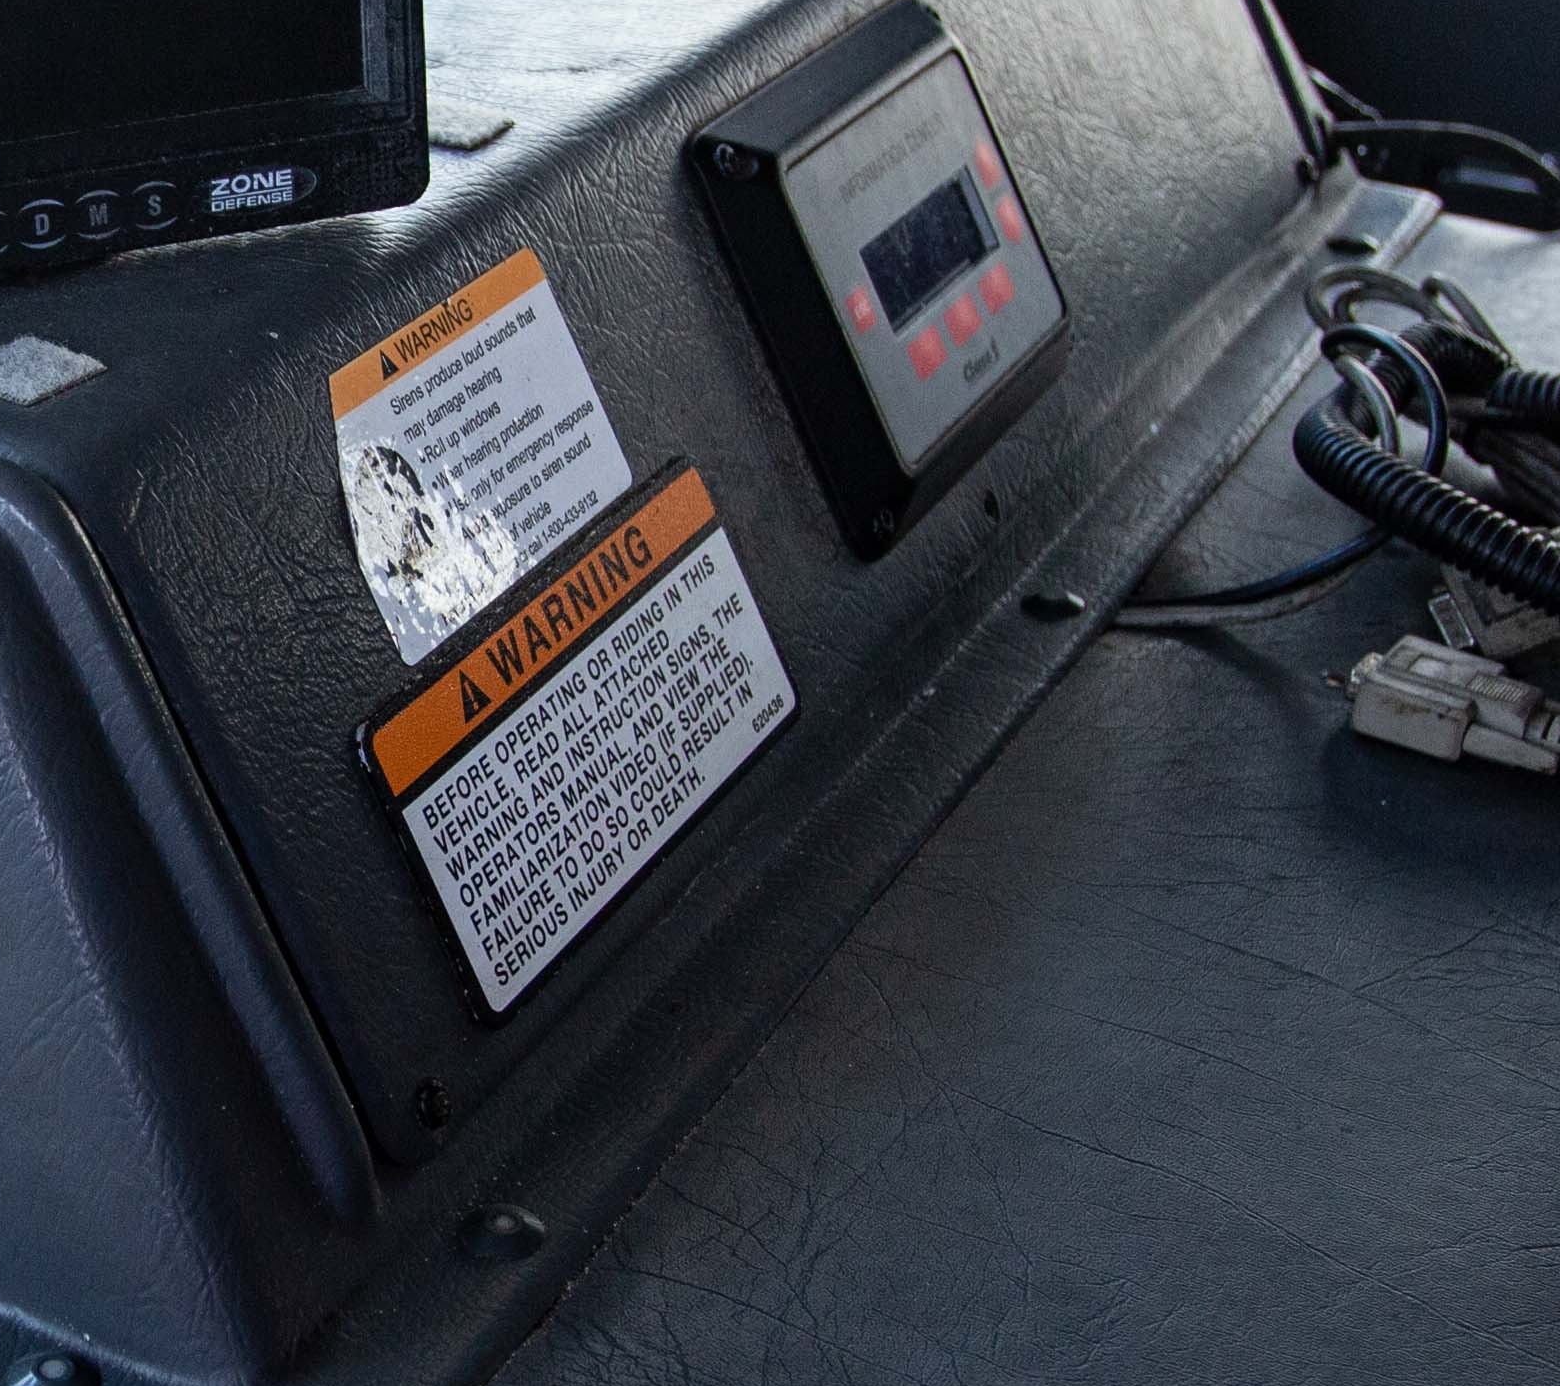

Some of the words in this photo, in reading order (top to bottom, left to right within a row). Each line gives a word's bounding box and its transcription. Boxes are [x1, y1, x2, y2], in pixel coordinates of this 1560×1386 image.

[34, 214, 51, 235] D
[89, 204, 110, 227] M
[148, 196, 162, 216] S
[210, 168, 293, 197] ZONE
[210, 187, 294, 213] DEFENSE
[390, 386, 424, 415] Sirens
[424, 359, 463, 397] produce
[461, 341, 485, 366] loud
[484, 320, 518, 352] sounds
[516, 306, 536, 329] that
[394, 298, 474, 363] WARNING
[404, 419, 427, 444] may
[430, 391, 466, 427] damage
[464, 366, 502, 399] hearing
[446, 431, 460, 449] up
[460, 401, 501, 436] windows
[462, 436, 502, 470] hearing
[500, 402, 545, 445] protection
[470, 477, 492, 501] only
[491, 466, 506, 486] for
[506, 430, 555, 478] emergency
[554, 400, 595, 436] response
[532, 473, 542, 489] to
[541, 455, 565, 481] siren
[564, 432, 592, 464] sound
[509, 522, 519, 542] of
[519, 501, 552, 533] vehicle
[529, 534, 544, 556] call
[486, 526, 654, 685] WARNING
[422, 754, 495, 830] BEFORE
[495, 672, 587, 764] OPERATING
[587, 649, 612, 680] OR
[611, 601, 664, 660] RIDING
[663, 584, 682, 611] IN
[680, 554, 715, 594] THIS
[433, 776, 516, 855] VEHICLE,
[513, 731, 560, 784] READ
[562, 704, 593, 741] ALL
[593, 629, 670, 712] ATTACHED
[445, 797, 529, 882] WARNING
[530, 762, 565, 807] AND
[565, 665, 667, 771] INSTRUCTION
[666, 624, 717, 675] SIGNS,
[712, 592, 743, 629] THE
[459, 802, 561, 907] OPERATORS
[560, 741, 633, 812] MANUAL,
[632, 703, 664, 745] AND
[663, 665, 700, 711] VIEW
[700, 637, 730, 675] THE
[470, 789, 610, 935] FAMILIARIZATION
[609, 744, 657, 797] VIDEO
[658, 721, 676, 756] (IF
[678, 651, 753, 731] SUPPLIED).
[482, 879, 555, 961] FAILURE
[553, 856, 578, 888] TO
[579, 830, 604, 865] DO
[605, 806, 629, 838] SO
[631, 753, 681, 812] COULD
[682, 699, 736, 762] RESULT
[735, 680, 753, 708] IN
[494, 902, 569, 986] SERIOUS
[567, 842, 625, 912] INJURY
[628, 819, 652, 851] OR
[651, 767, 706, 827] DEATH.
